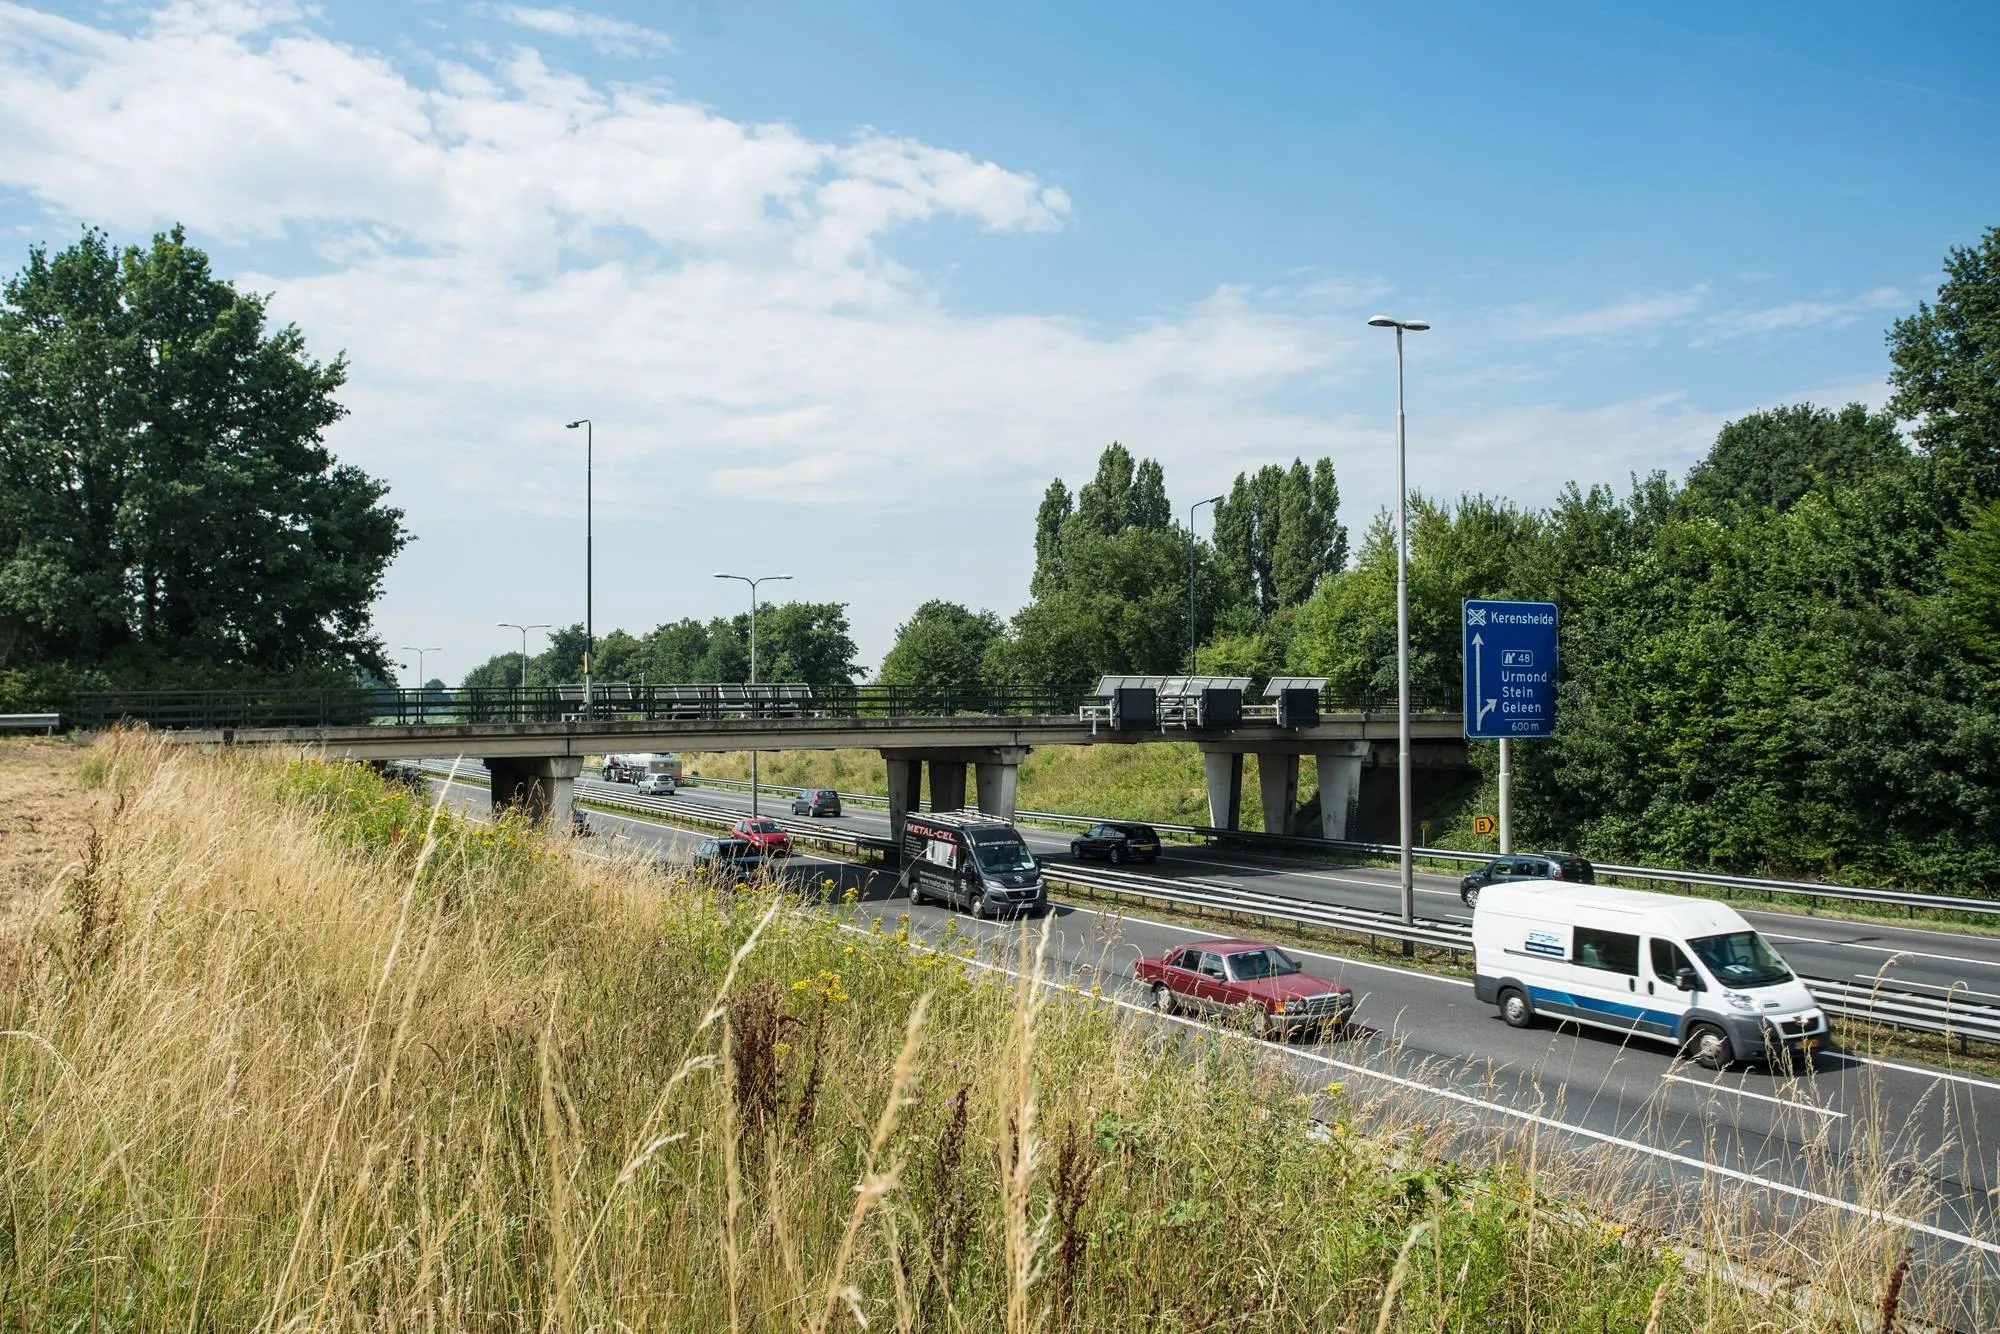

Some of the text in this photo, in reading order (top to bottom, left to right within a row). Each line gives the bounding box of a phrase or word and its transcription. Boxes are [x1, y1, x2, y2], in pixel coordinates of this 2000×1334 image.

[1491, 611, 1554, 625] Kerensheide
[1518, 654, 1530, 663] 48
[1501, 671, 1547, 682] Urmond
[1502, 686, 1533, 698] Stein
[1502, 702, 1541, 713] Geleen
[1511, 722, 1539, 731] 600 m
[1479, 821, 1486, 831] B
